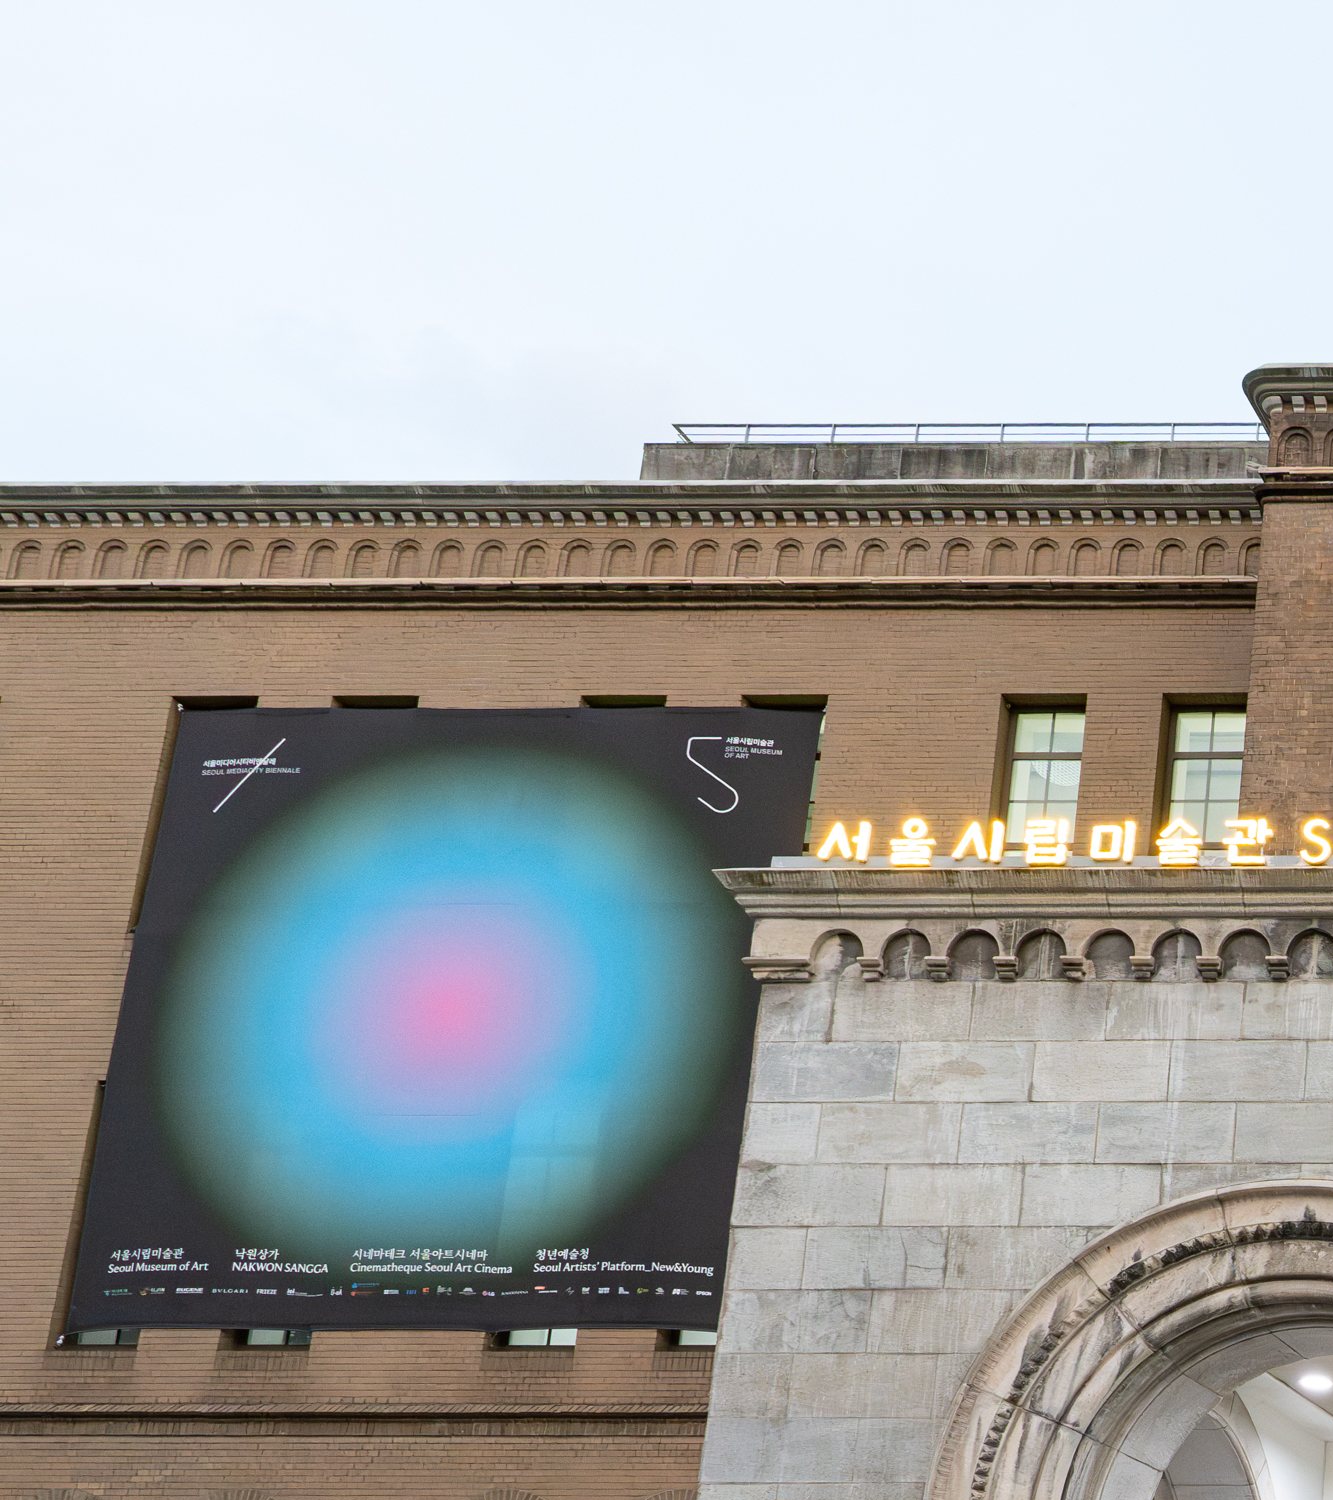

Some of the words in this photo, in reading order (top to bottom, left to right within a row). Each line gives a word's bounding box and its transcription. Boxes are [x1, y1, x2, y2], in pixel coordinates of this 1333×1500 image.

[726, 736, 774, 747] 서울시립미술관
[750, 747, 783, 755] MUSEUM
[816, 816, 1272, 866] 서울시립미술관
[110, 1248, 184, 1261] 서울시립미술관
[236, 1248, 279, 1260] 낙원상가
[352, 1248, 406, 1260] 시네마테크
[410, 1248, 488, 1261] 서울아트시네마
[536, 1248, 589, 1260] 청년예술청
[108, 1263, 134, 1273] Seoul
[135, 1262, 177, 1272] Museum
[179, 1261, 191, 1271] of
[191, 1262, 209, 1271] Art
[232, 1262, 283, 1272] NAKWON
[284, 1263, 328, 1273] SANGGA
[350, 1263, 422, 1274] Cinematheque
[425, 1263, 453, 1272] Seoul
[455, 1263, 472, 1272] Art
[474, 1264, 513, 1274] Cinema
[533, 1263, 561, 1272] Seoul
[601, 1262, 714, 1276] Platform_New&Young
